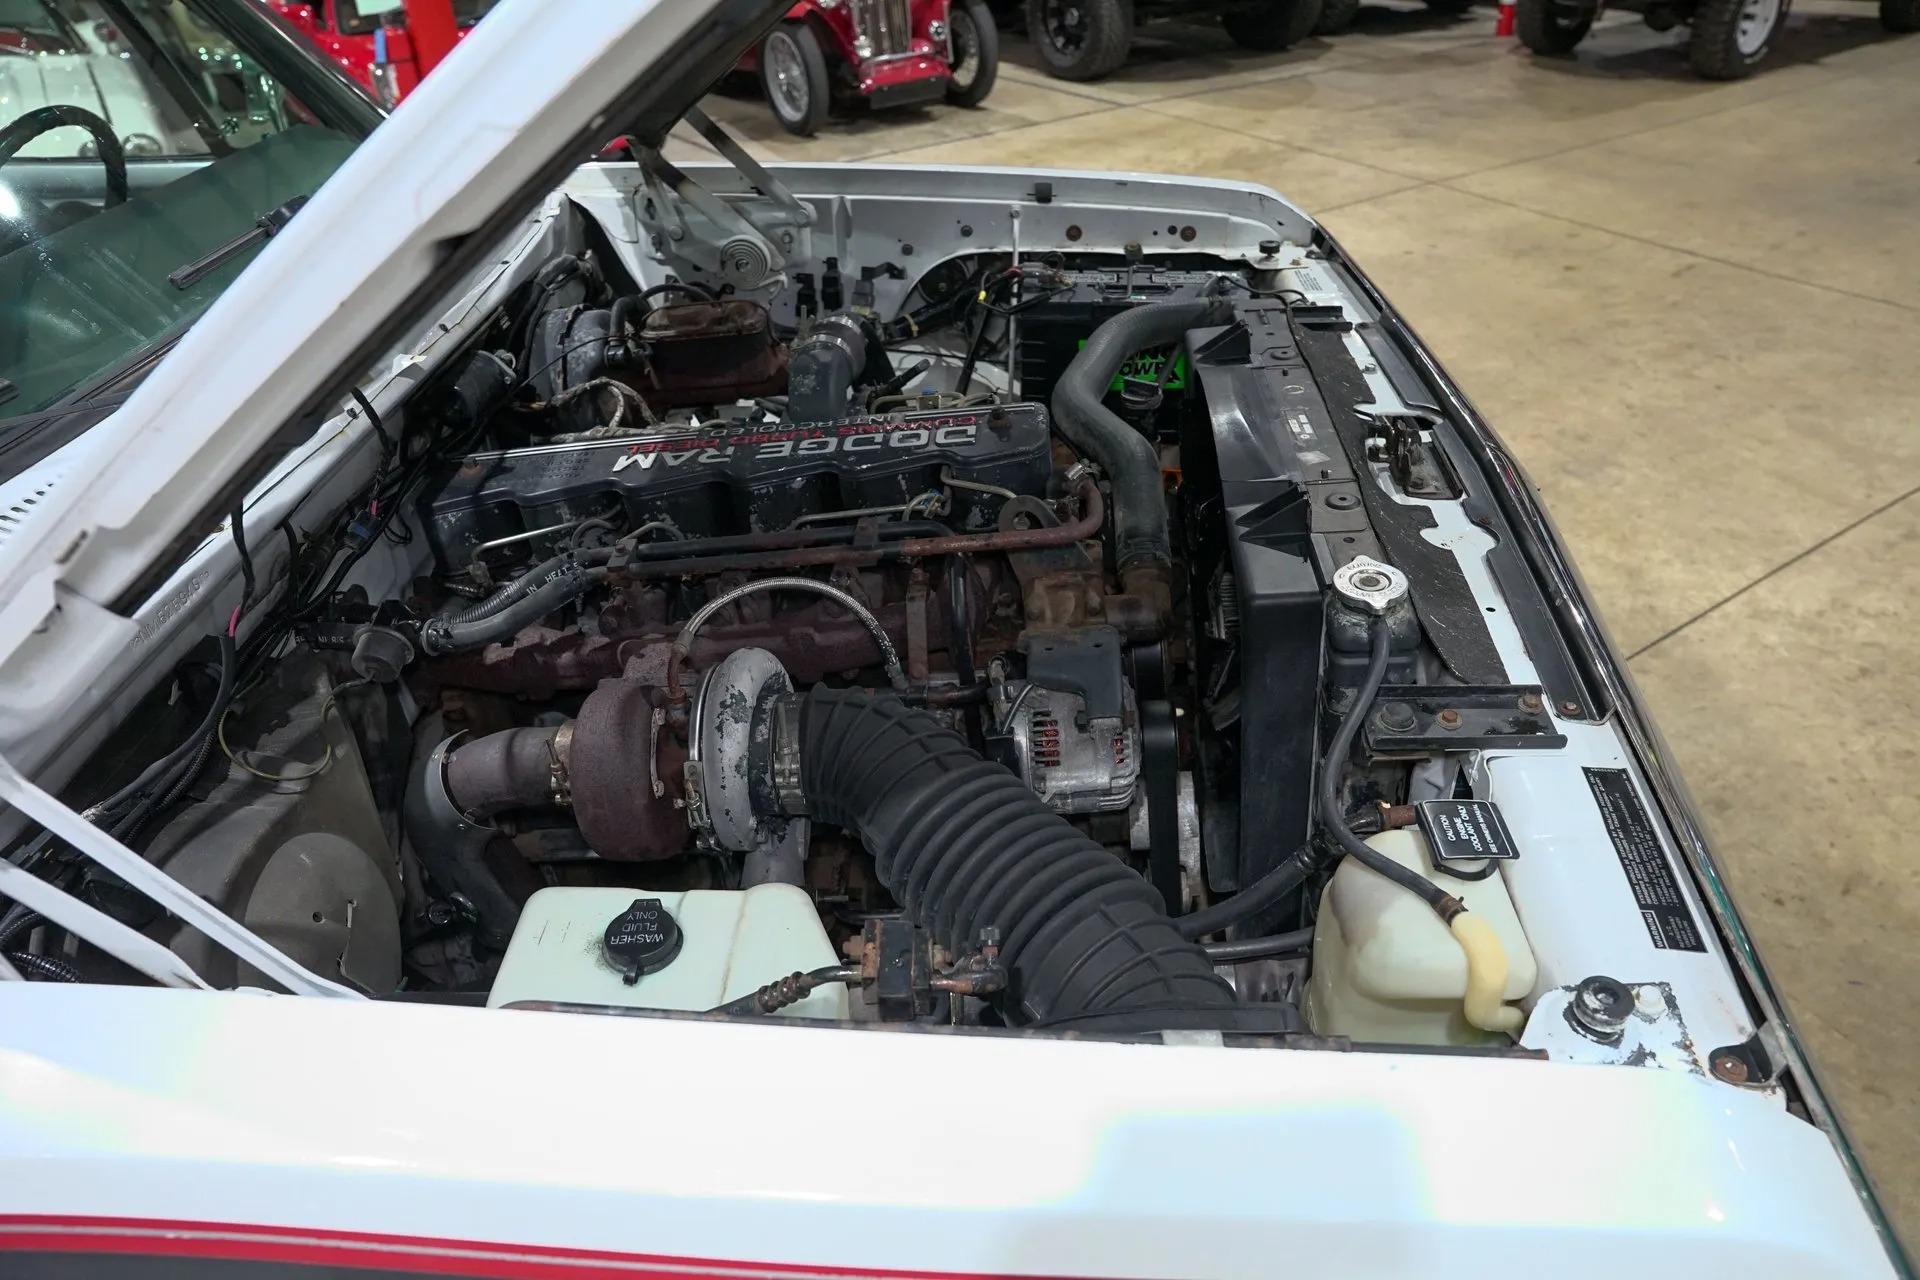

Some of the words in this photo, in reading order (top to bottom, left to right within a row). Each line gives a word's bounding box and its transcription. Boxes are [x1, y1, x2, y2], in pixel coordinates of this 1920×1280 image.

[711, 413, 893, 436] INTERCOOLED
[837, 415, 976, 436] CUMMINS
[629, 438, 719, 455] DIESEL
[729, 430, 824, 445] TURBO
[755, 425, 976, 459] DODGE
[612, 446, 736, 472] RAM
[1456, 804, 1469, 819] ONLY
[1471, 803, 1484, 822] MANUAL
[1438, 814, 1456, 840] CAUTION
[1452, 817, 1469, 839] ENGINE
[1463, 822, 1483, 851] COOLANT
[1488, 843, 1498, 852] SEE
[1634, 885, 1646, 904] SYSTEM
[626, 911, 658, 921] ONLY
[622, 922, 658, 932] FLUID
[1644, 912, 1664, 947] WARNING
[610, 933, 664, 945] WASHER
